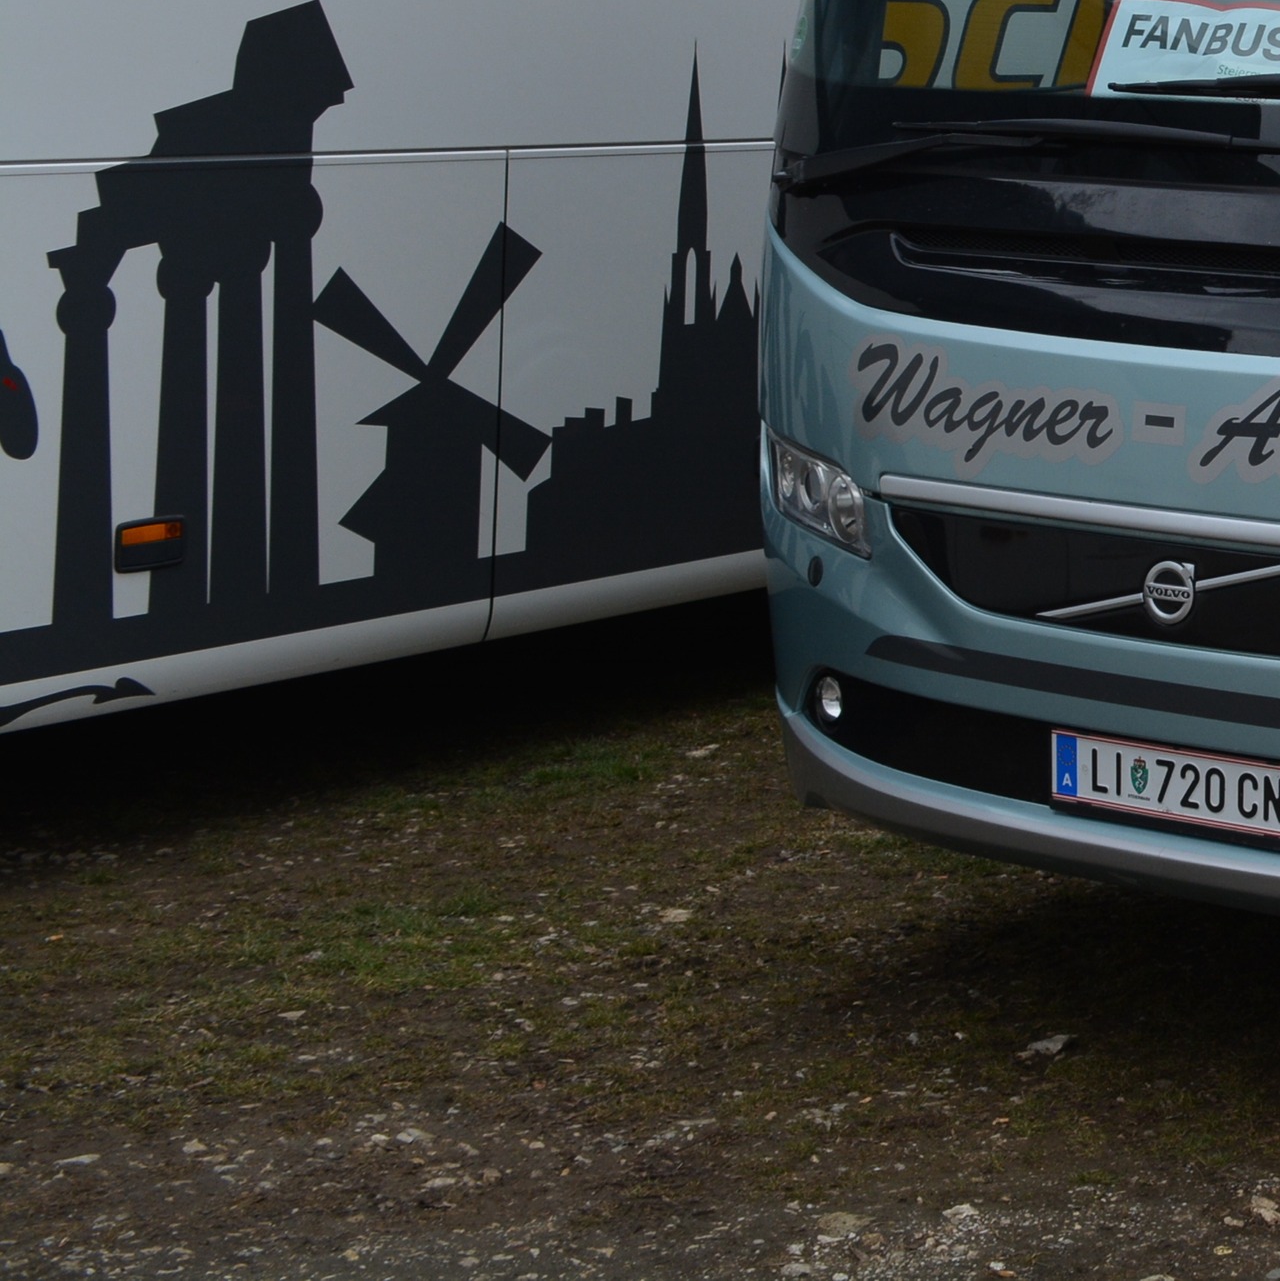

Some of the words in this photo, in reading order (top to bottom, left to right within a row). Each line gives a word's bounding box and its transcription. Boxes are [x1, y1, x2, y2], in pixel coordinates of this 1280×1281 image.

[856, 344, 1114, 462] Wagner
[1146, 586, 1191, 599] VOLVO
[1062, 772, 1073, 787] A
[1091, 748, 1122, 796] LI
[1155, 758, 1226, 813] 720
